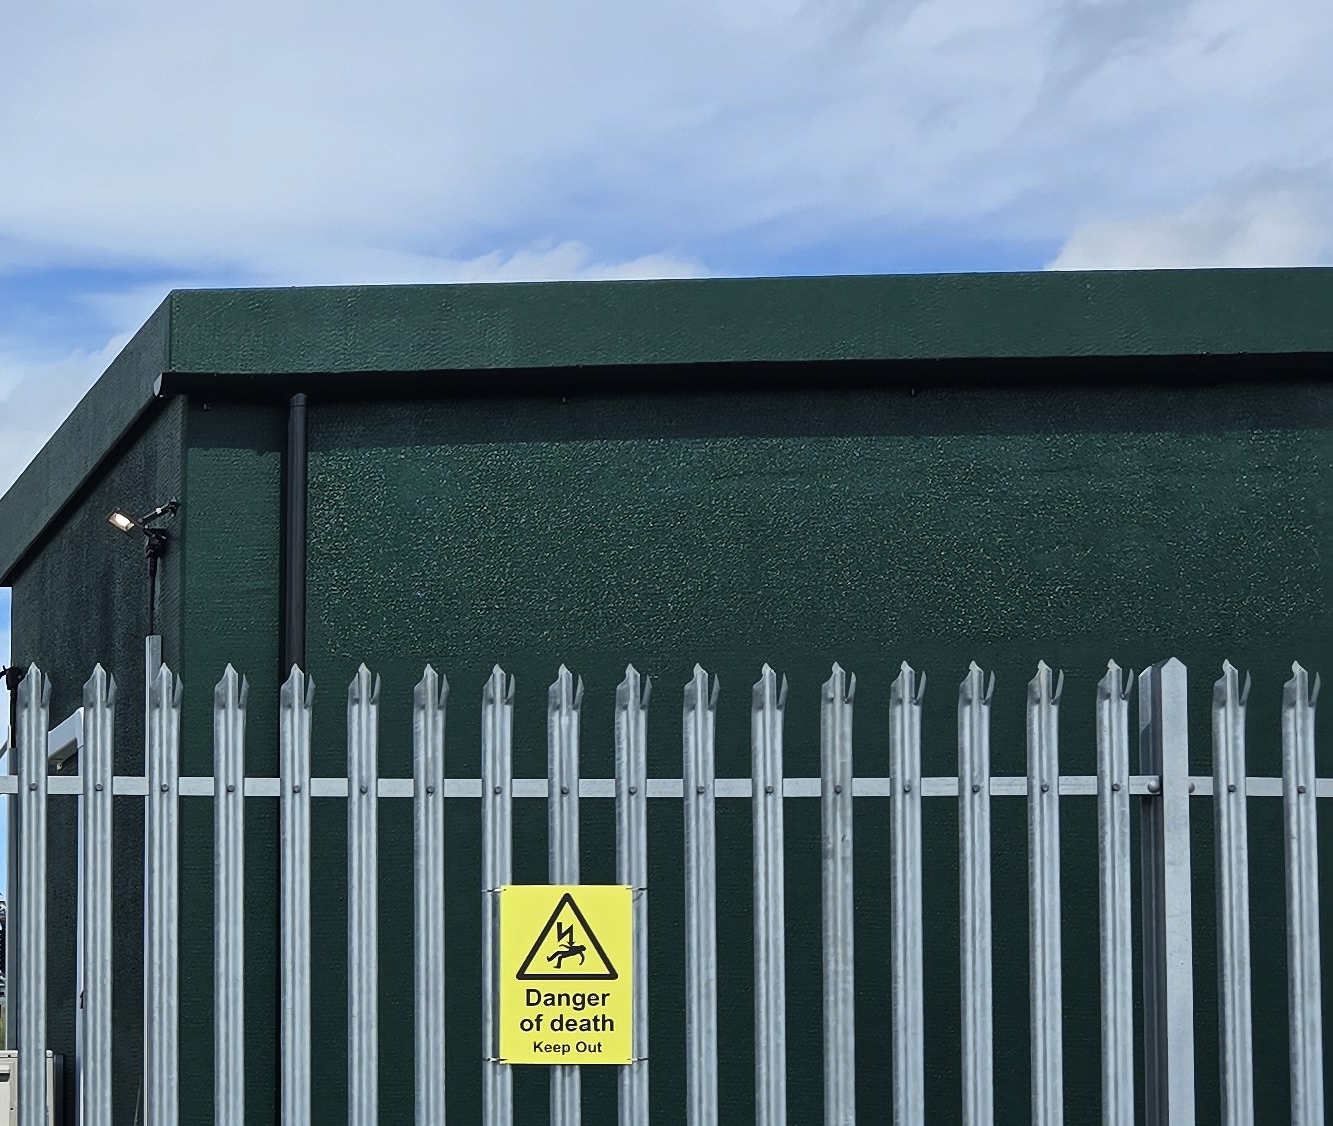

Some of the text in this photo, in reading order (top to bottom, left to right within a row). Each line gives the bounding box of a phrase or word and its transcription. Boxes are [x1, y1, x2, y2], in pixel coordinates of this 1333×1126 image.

[525, 988, 611, 1012] Danger
[519, 1013, 615, 1033] of death
[533, 1040, 603, 1056] Keep Out
